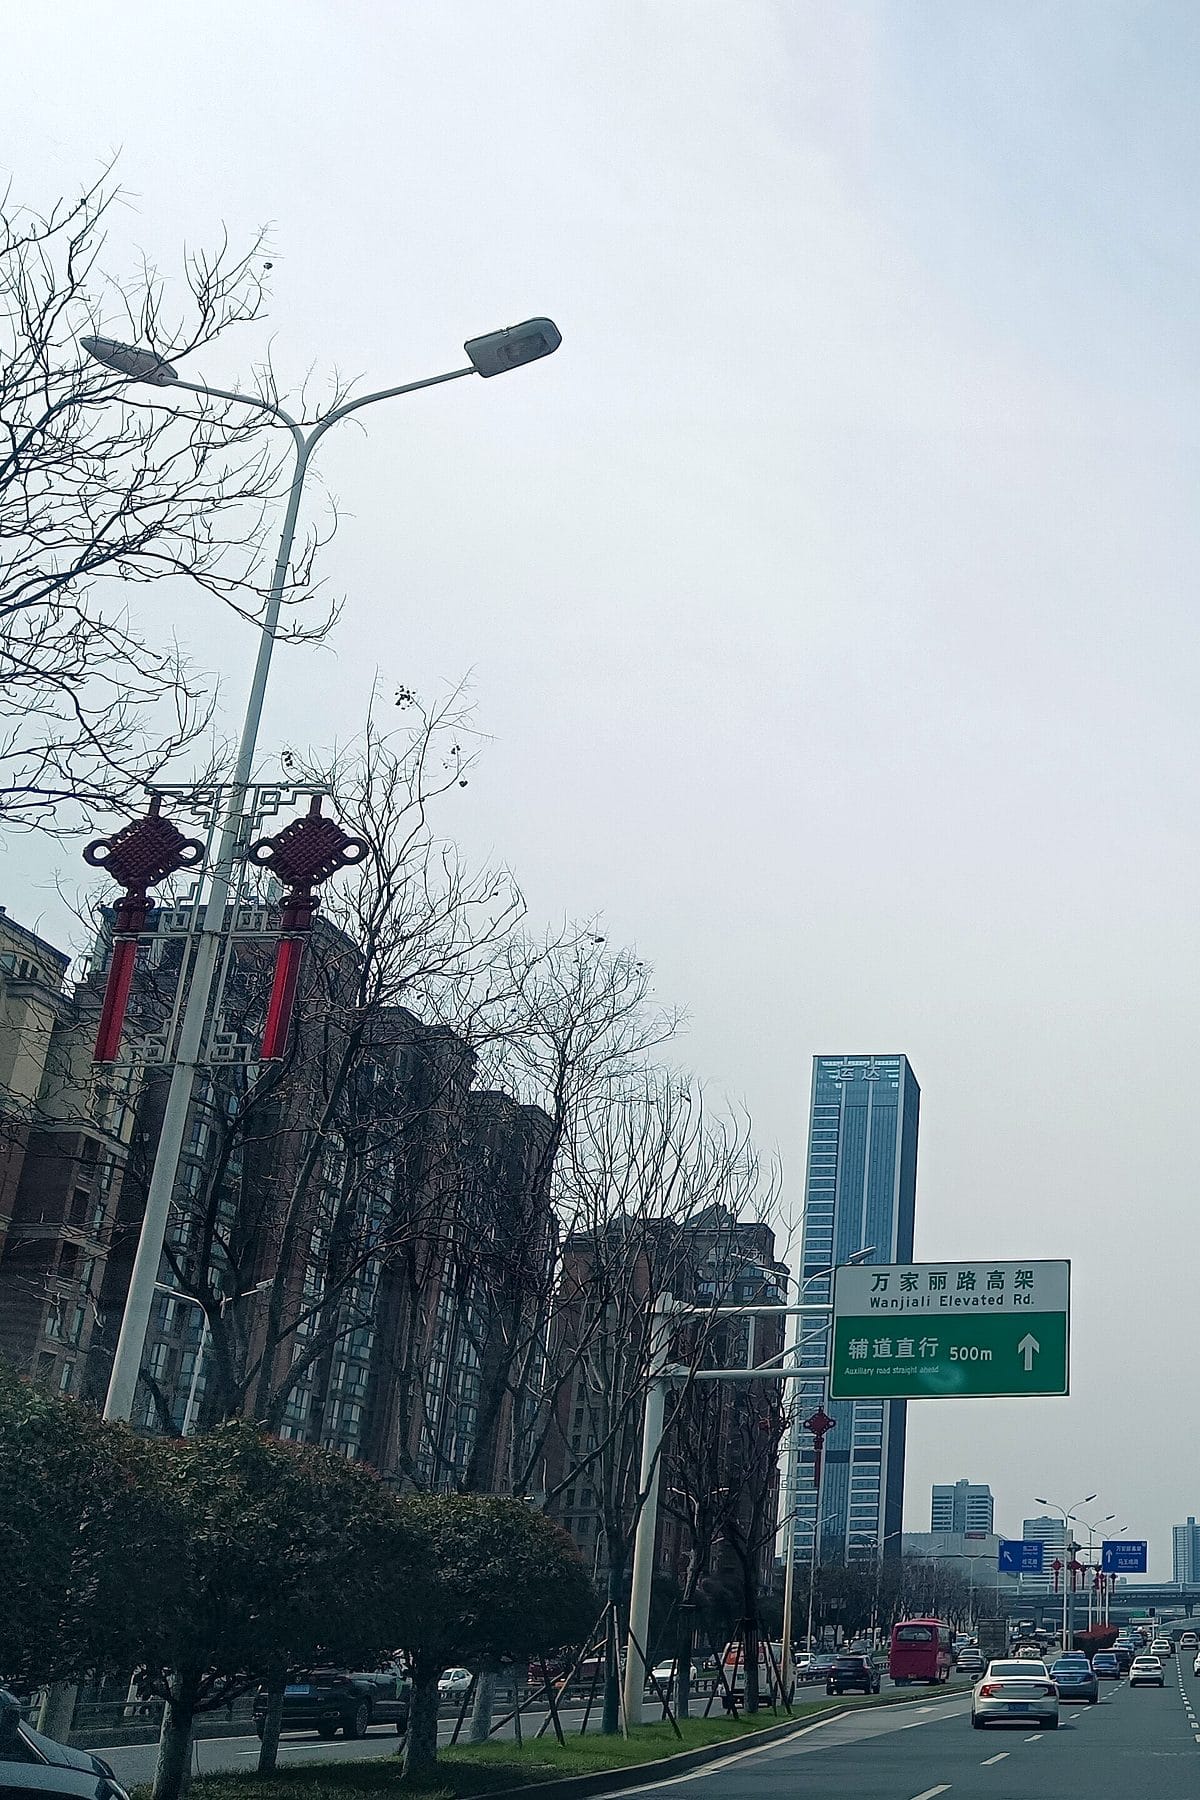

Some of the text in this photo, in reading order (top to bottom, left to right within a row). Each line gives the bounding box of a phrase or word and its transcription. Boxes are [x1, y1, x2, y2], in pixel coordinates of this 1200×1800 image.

[835, 1064, 881, 1081] 运达
[870, 1269, 1034, 1292] 万家丽路高架
[870, 1293, 1035, 1311] Wanjiali Elevated Rd.
[848, 1337, 939, 1360] 辅道直行
[950, 1347, 992, 1361] 500m
[876, 1366, 891, 1374] road
[892, 1365, 917, 1376] straight
